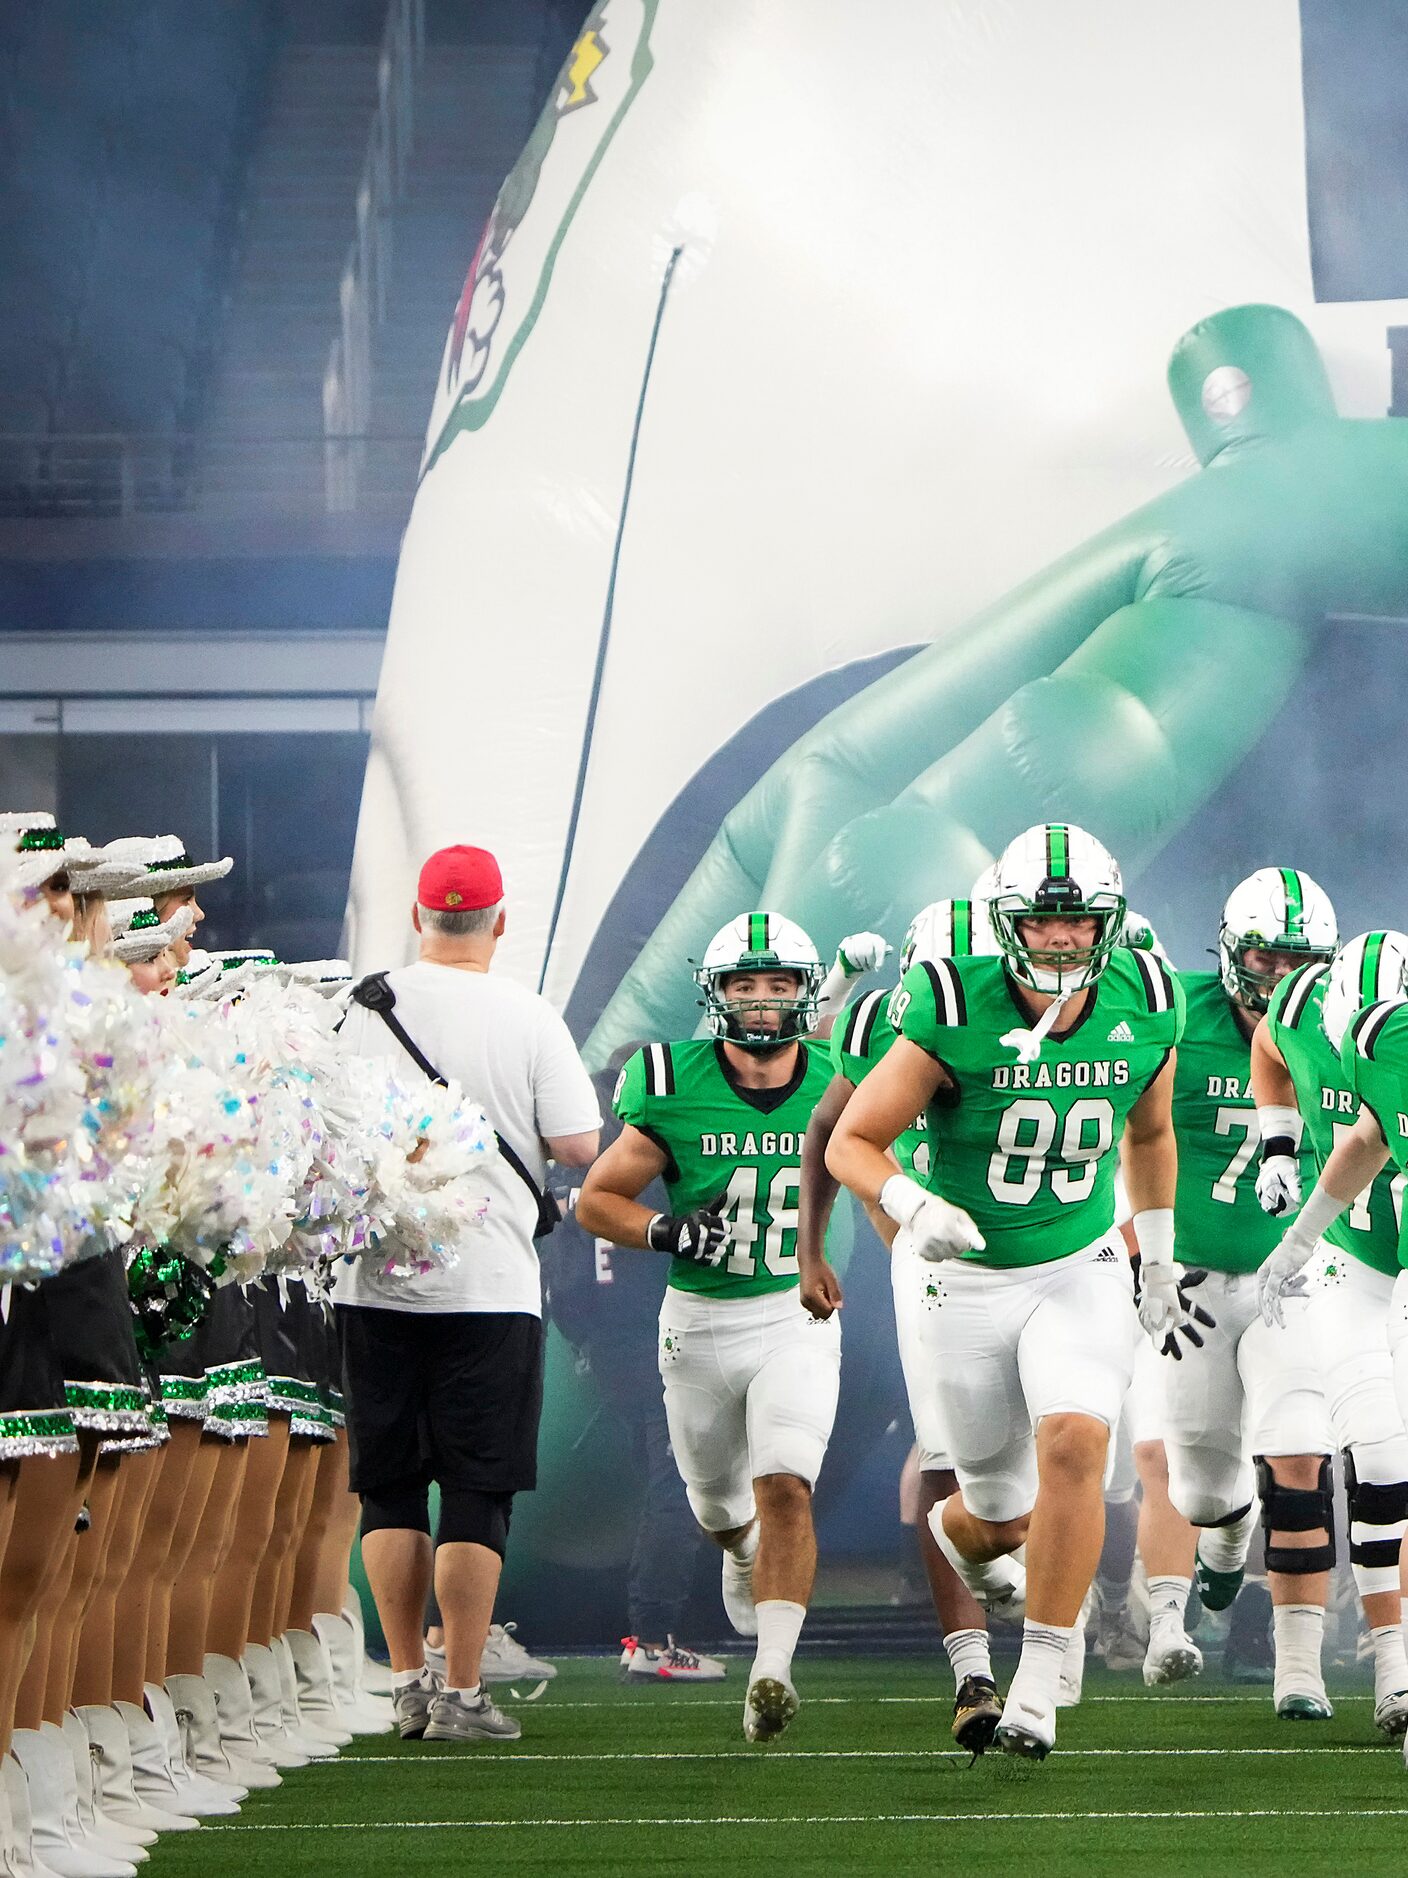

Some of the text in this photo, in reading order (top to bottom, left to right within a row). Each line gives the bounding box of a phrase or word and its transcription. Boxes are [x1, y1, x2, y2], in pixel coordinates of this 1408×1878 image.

[1107, 1033, 1134, 1042] adidas
[992, 1060, 1130, 1089] DRAGONS
[987, 1098, 1115, 1206] 89
[719, 1166, 801, 1277] 48
